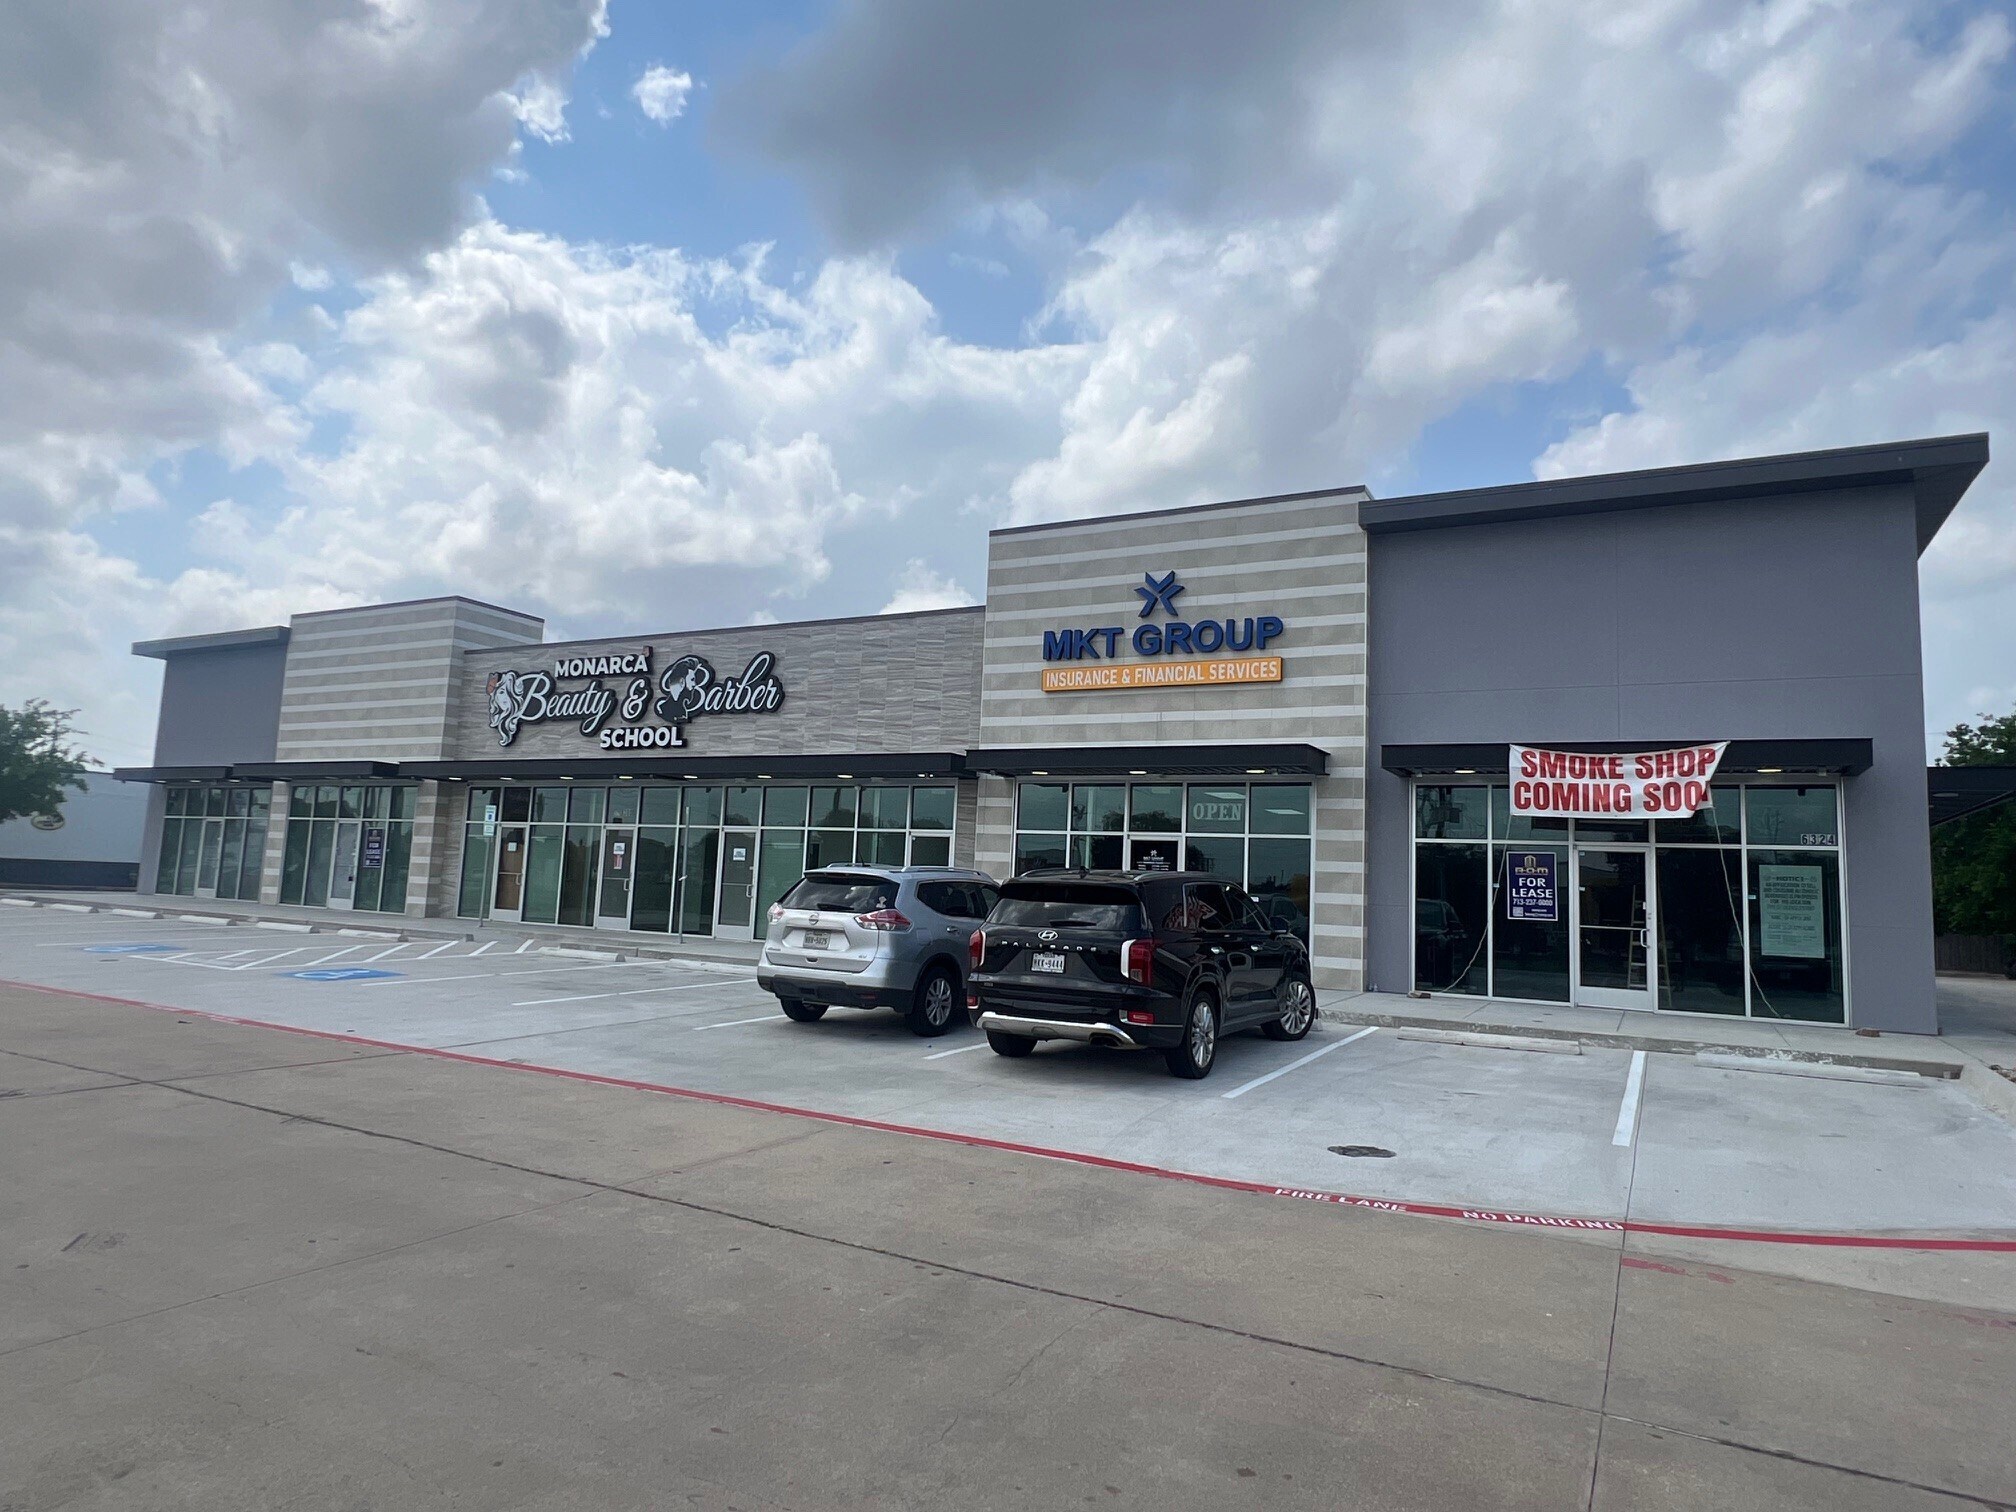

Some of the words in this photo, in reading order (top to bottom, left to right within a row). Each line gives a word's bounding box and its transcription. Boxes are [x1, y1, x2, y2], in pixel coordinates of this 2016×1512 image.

[1043, 627, 1124, 661] MKT
[1132, 616, 1284, 656] GROUP
[555, 653, 649, 678] MONARCA
[1046, 669, 1118, 688] INSURANCE
[1121, 668, 1131, 684] &
[1134, 664, 1204, 684] FINANCIAL
[1209, 660, 1278, 681] SERVICES
[517, 672, 612, 734] Beauty
[626, 678, 648, 720] &
[656, 652, 780, 715] Barber
[600, 727, 683, 748] SCHOOL
[1520, 750, 1625, 779] SMOKE
[1634, 748, 1716, 779] SHOP
[1513, 780, 1632, 812] COMING
[1192, 803, 1243, 821] OPEN
[1801, 833, 1835, 845] 6324
[1512, 888, 1553, 898] LEASE
[1518, 877, 1546, 887] FOR
[1274, 1188, 1331, 1201] FIRE
[1338, 1196, 1408, 1212] LANE
[1462, 1210, 1498, 1221] NO
[1504, 1213, 1625, 1231] PARKING
